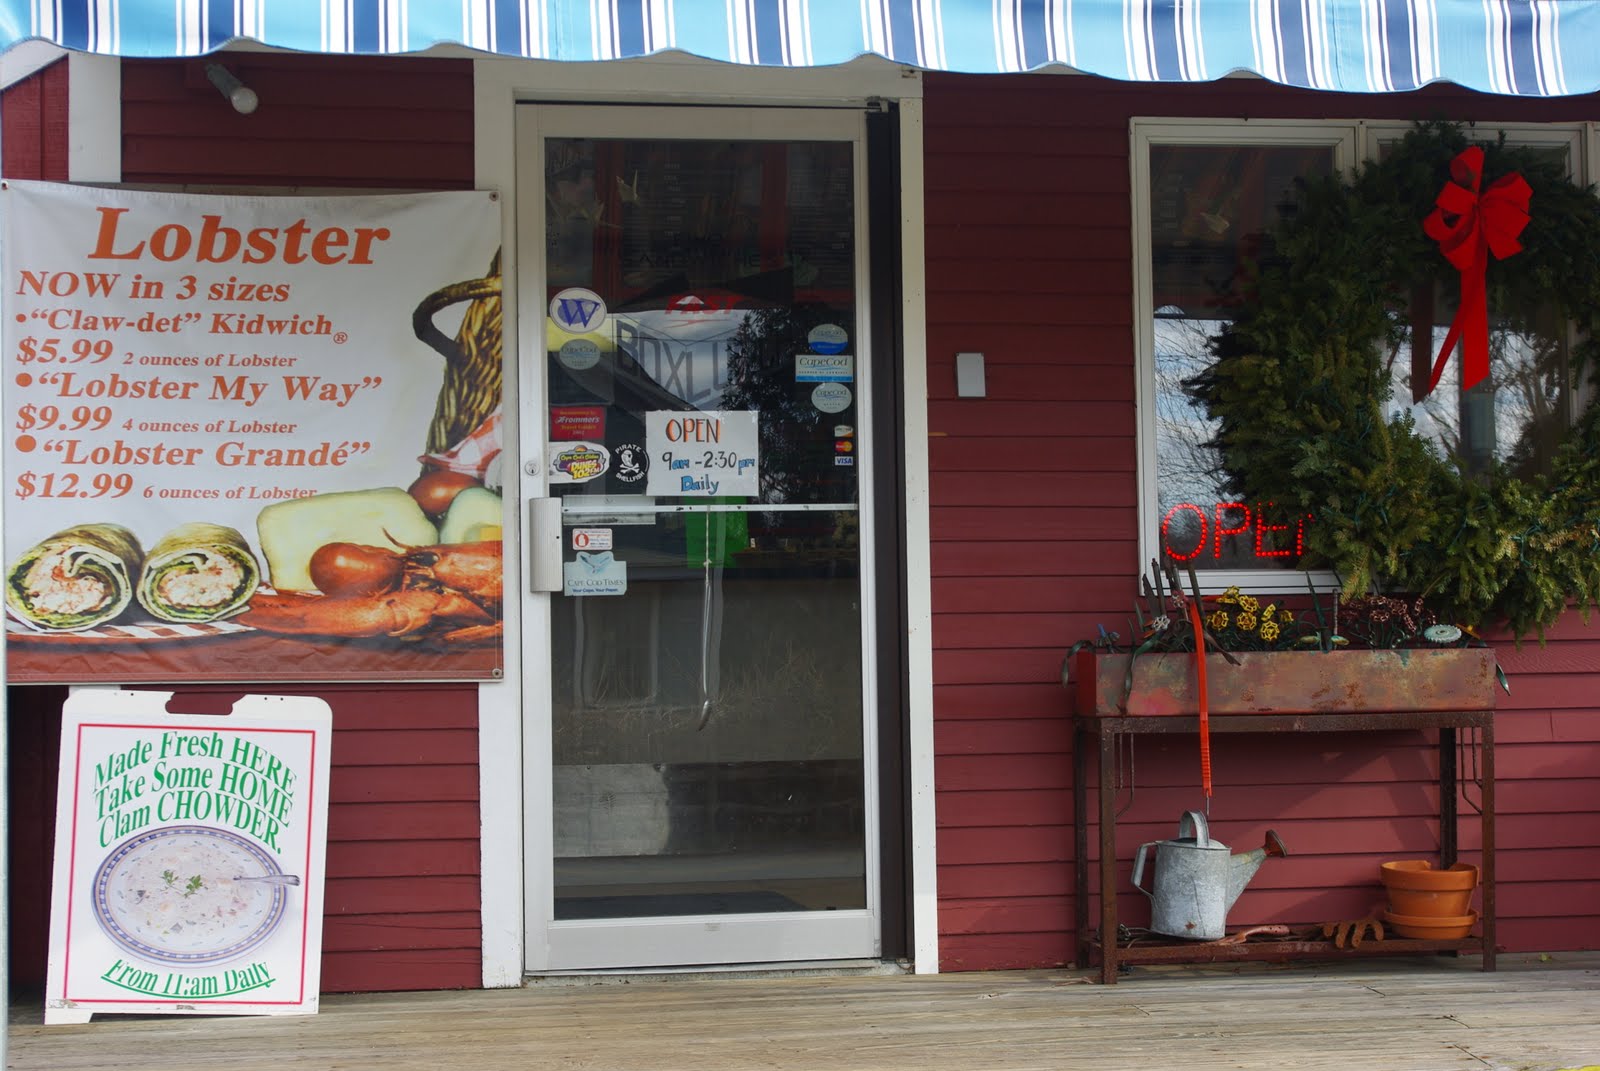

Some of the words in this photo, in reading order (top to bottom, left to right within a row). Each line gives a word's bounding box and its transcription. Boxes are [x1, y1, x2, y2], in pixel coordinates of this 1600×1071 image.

[87, 206, 391, 265] Lobster
[15, 271, 121, 298] NOW
[128, 274, 164, 299] in
[176, 275, 197, 300] 3
[208, 276, 290, 302] sizes
[16, 336, 113, 365] $5.99
[122, 352, 134, 365] 2
[139, 355, 199, 366] ounces
[204, 354, 224, 367] of
[227, 354, 297, 367] Lobster
[208, 375, 269, 407] My
[16, 403, 112, 433] $9.99
[122, 418, 133, 431] 4
[138, 421, 199, 432] ounces
[204, 420, 225, 433] of
[227, 420, 297, 434] Lobster
[665, 417, 721, 443] OPEN
[615, 443, 642, 454] PIRATE
[15, 471, 133, 500] $12.99
[143, 485, 155, 499] 6
[159, 488, 220, 499] ounces
[225, 486, 245, 499] of
[248, 486, 317, 499] Lobster
[615, 470, 645, 482] SHELLFISH
[681, 474, 719, 495] Daily
[93, 740, 152, 793] Made
[157, 731, 224, 759] Fresh
[229, 736, 297, 797] HERE
[95, 773, 146, 822] Take
[151, 761, 213, 792] Some
[218, 762, 293, 828] HOME
[99, 804, 150, 848] Clam
[104, 959, 159, 992] From
[225, 962, 273, 988] Daily
